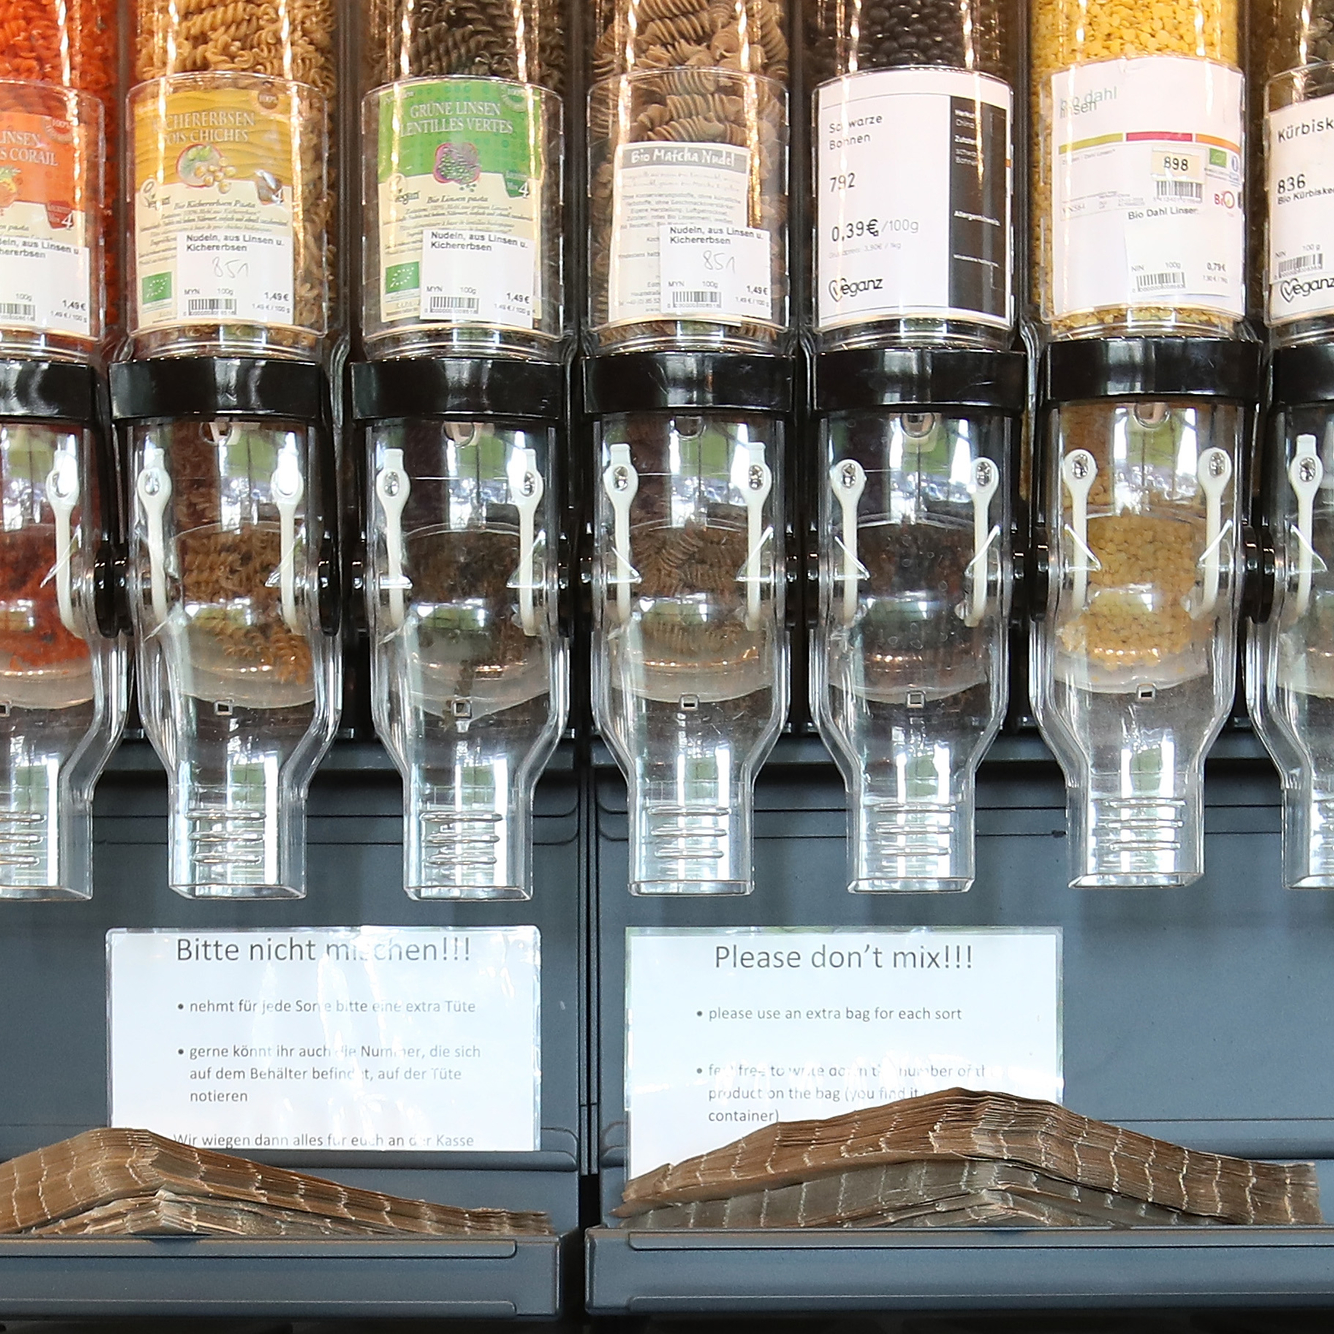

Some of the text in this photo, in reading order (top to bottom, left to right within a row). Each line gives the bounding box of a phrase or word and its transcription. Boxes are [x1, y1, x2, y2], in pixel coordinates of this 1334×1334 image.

[1083, 86, 1118, 106] dahl
[457, 102, 501, 116] LINSEN
[467, 119, 513, 135] VERTES
[190, 130, 249, 142] CHICHES
[9, 149, 58, 166] CORAIL
[631, 148, 735, 167] Bio Matcha Nudel
[1163, 156, 1189, 171] 898
[518, 181, 530, 199] 4
[829, 172, 855, 192] 792
[1277, 174, 1306, 194] 836
[61, 213, 74, 230] 4
[1128, 207, 1167, 220] Bio Dahl
[882, 219, 919, 234] /100g
[22, 240, 38, 248] aus
[42, 240, 71, 253] Linsen
[186, 234, 274, 245] Nudeln, aus Linsen
[186, 244, 247, 252] Kichererbsen
[212, 257, 249, 278] 851
[703, 250, 736, 273] 851
[176, 937, 316, 962] Bitte nicht
[714, 944, 802, 969] Please
[892, 944, 973, 969] mix!!!
[189, 1000, 234, 1013] nehmt
[238, 999, 257, 1013] für
[405, 1001, 441, 1013] extra
[444, 1000, 476, 1013] Tüte
[708, 1006, 963, 1023] please use an extra bag for each sort
[189, 1044, 481, 1060] gerne ihr auch die sich
[189, 1067, 427, 1080] auf dem Behälter auf der
[189, 1089, 248, 1103] notieren
[766, 1088, 785, 1100] on
[788, 1086, 812, 1100] the
[815, 1086, 841, 1102] bag
[708, 1108, 779, 1123] container)
[201, 1133, 474, 1149] wiegen dann alles an Kasse
